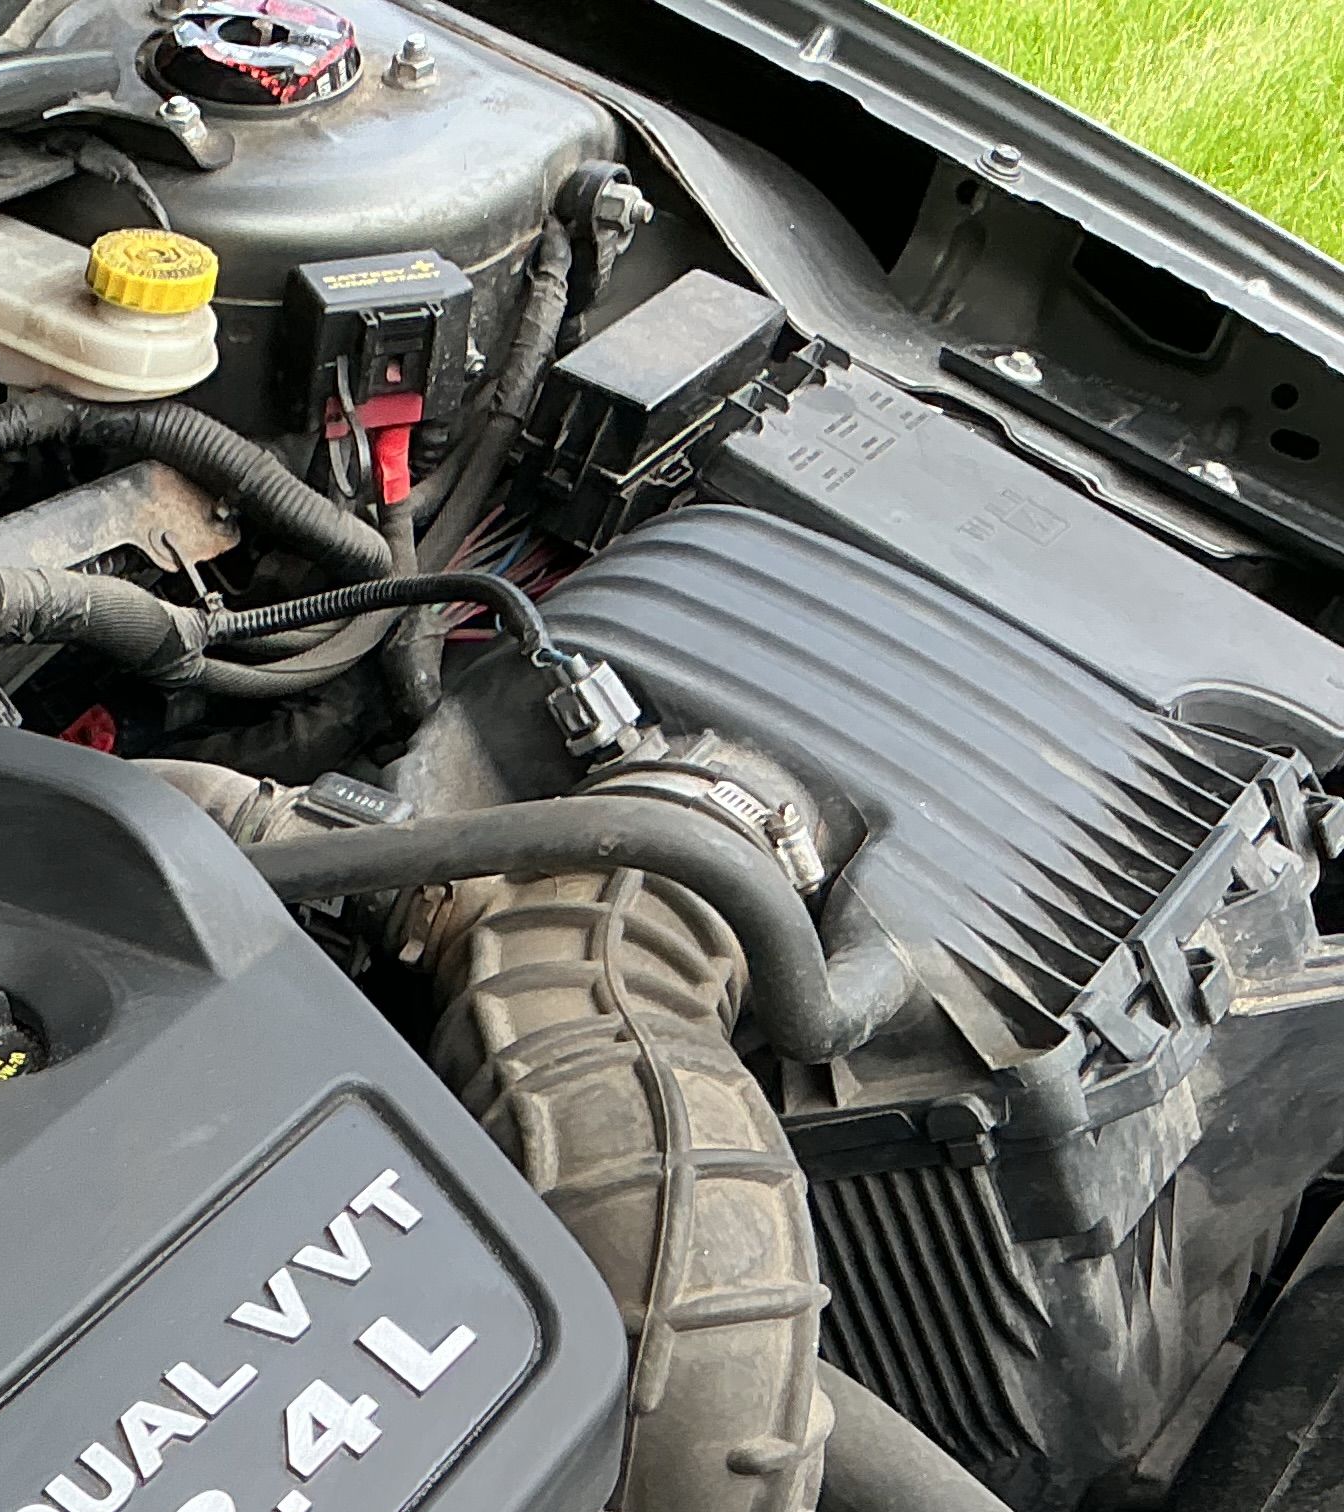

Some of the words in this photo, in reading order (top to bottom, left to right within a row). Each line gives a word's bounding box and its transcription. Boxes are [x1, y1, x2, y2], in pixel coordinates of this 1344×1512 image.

[322, 268, 405, 283] BATTERY
[383, 270, 441, 284] START
[225, 1168, 423, 1343] VVT
